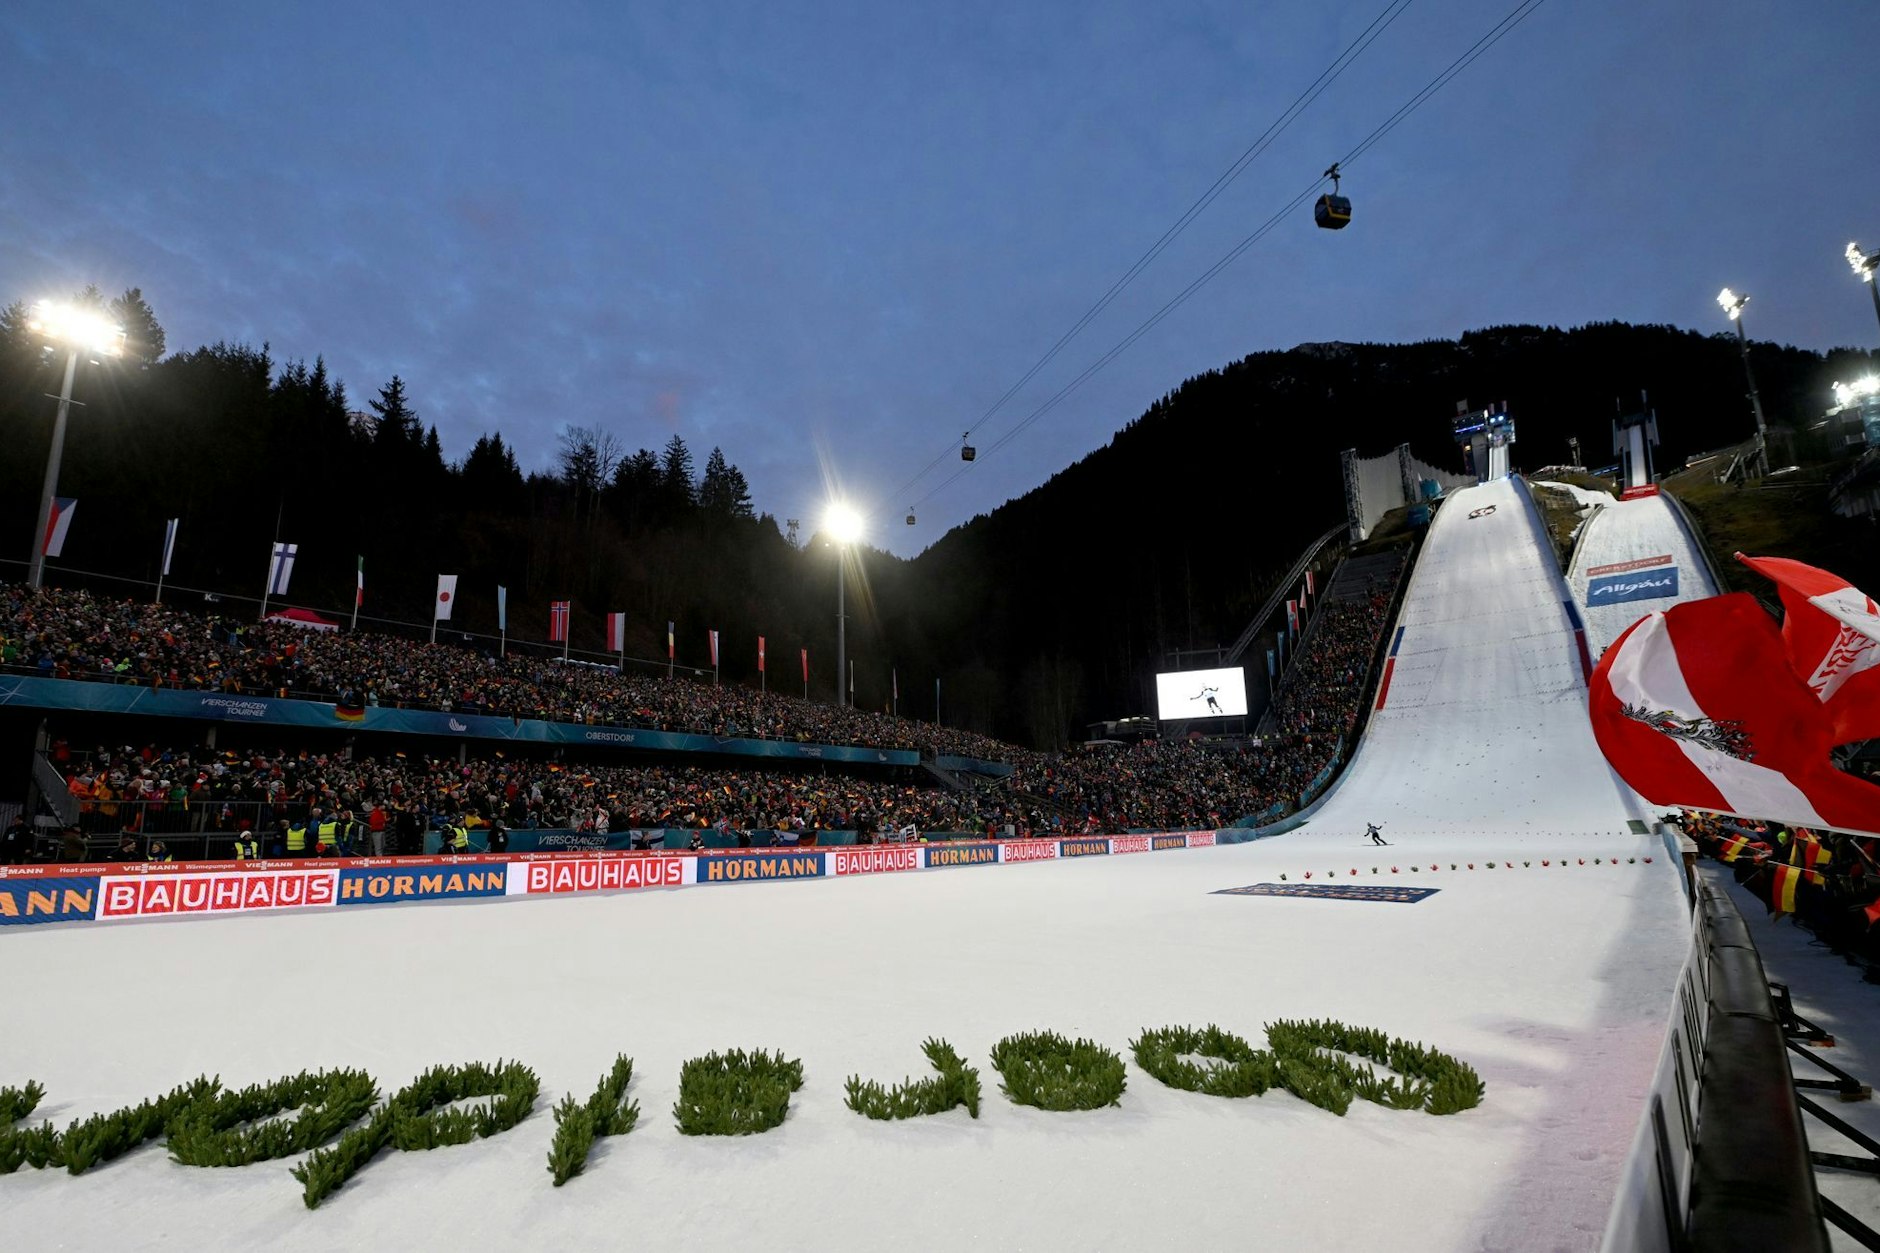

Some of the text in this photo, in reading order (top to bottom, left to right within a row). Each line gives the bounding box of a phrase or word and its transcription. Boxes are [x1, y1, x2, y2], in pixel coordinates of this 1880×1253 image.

[1593, 578, 1671, 596] Allgäu
[201, 698, 268, 710] VIERSCHANZEN
[227, 707, 266, 717] TOURNEE
[585, 731, 635, 742] OBERSTDORF
[538, 835, 608, 846] VIERSCHANZEN
[1063, 842, 1106, 856] HÖRMANN
[1114, 839, 1149, 853] BAUHAUS
[931, 846, 994, 865] HÖRMANN
[1005, 843, 1055, 860] BAUHAUS
[60, 866, 78, 874] Heat
[80, 866, 107, 874] pumps
[123, 863, 178, 875] VIESSMANN
[185, 863, 236, 871] Wärmepumpen
[246, 860, 293, 871] VIESSMANN
[708, 857, 818, 881] HÖRMANN
[837, 850, 916, 873] BAUHAUS
[531, 861, 682, 891] BAUHAUS
[341, 871, 504, 899] HÖRMANN
[109, 877, 331, 911] BAUHAUS
